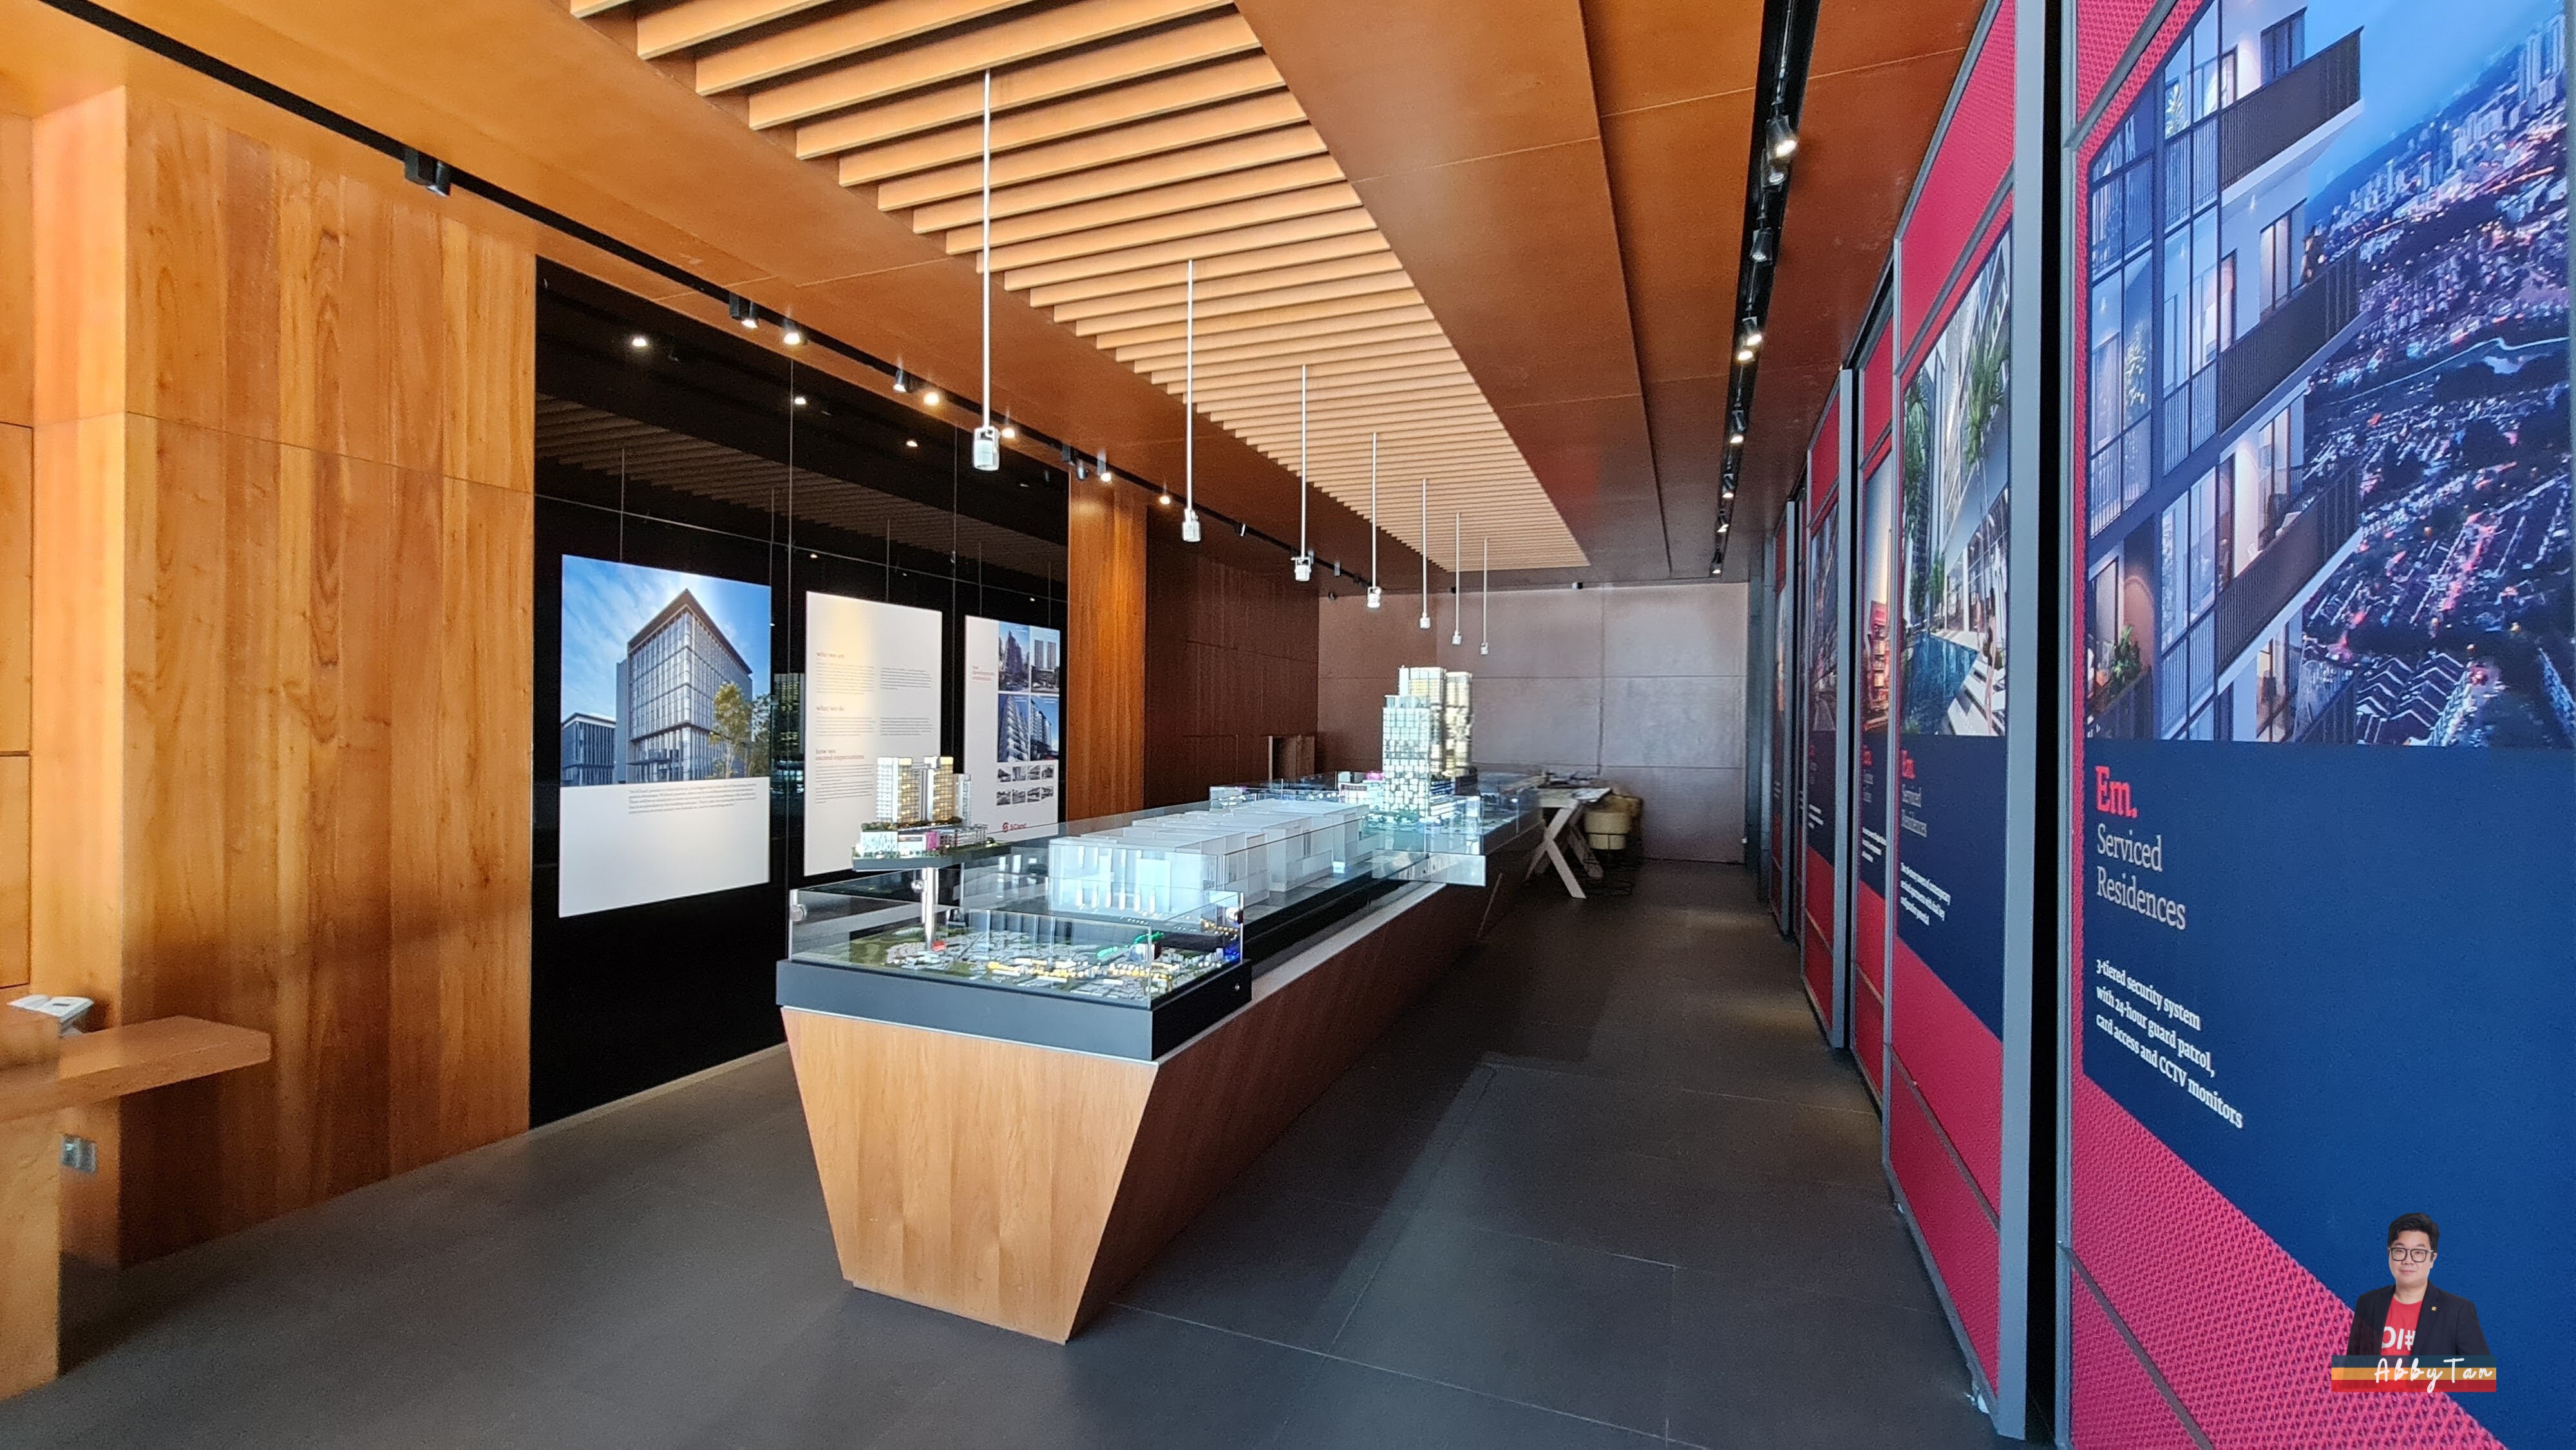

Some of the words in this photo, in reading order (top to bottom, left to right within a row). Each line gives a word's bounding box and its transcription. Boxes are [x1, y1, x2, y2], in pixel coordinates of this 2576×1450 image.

[2096, 766, 2137, 818] Em.
[2097, 823, 2163, 872] Serviced
[2097, 866, 2186, 930] Residences
[2096, 959, 2126, 986] 3-tiered
[2126, 977, 2163, 1011] security
[2163, 998, 2201, 1031] system
[2096, 986, 2114, 1008] with
[2115, 999, 2148, 1030] 24-hour
[2148, 1020, 2177, 1049] guard
[2177, 1038, 2215, 1078] patrol,
[2096, 1014, 2113, 1035] card
[2114, 1026, 2140, 1054] access
[2140, 1045, 2158, 1068] and
[2159, 1056, 2187, 1087] CCTV
[2188, 1078, 2243, 1129] monitors
